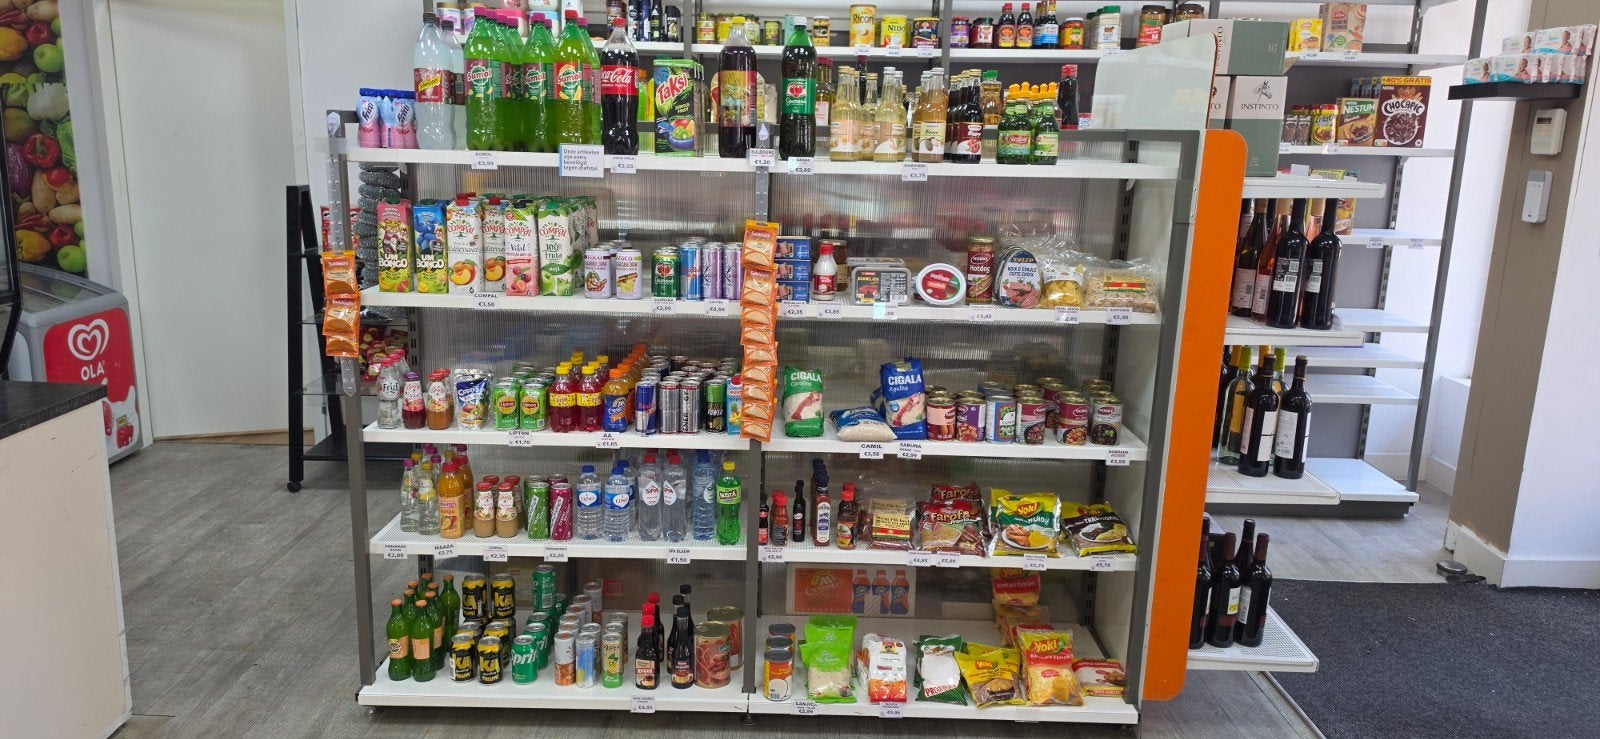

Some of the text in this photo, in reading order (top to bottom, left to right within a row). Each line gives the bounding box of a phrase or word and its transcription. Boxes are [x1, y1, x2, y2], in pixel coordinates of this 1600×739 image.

[1344, 102, 1375, 114] NESTUM
[1384, 102, 1424, 114] CHOCAPIC
[379, 258, 408, 268] BONGO
[416, 258, 444, 268] BONGO
[80, 365, 104, 381] OLA
[790, 372, 822, 382] CIGALA
[888, 374, 922, 386] CIGALA
[930, 509, 970, 521] Farofa
[1018, 502, 1038, 516] Yoki
[1035, 640, 1058, 652] Yoki
[977, 660, 994, 668] Yoki
